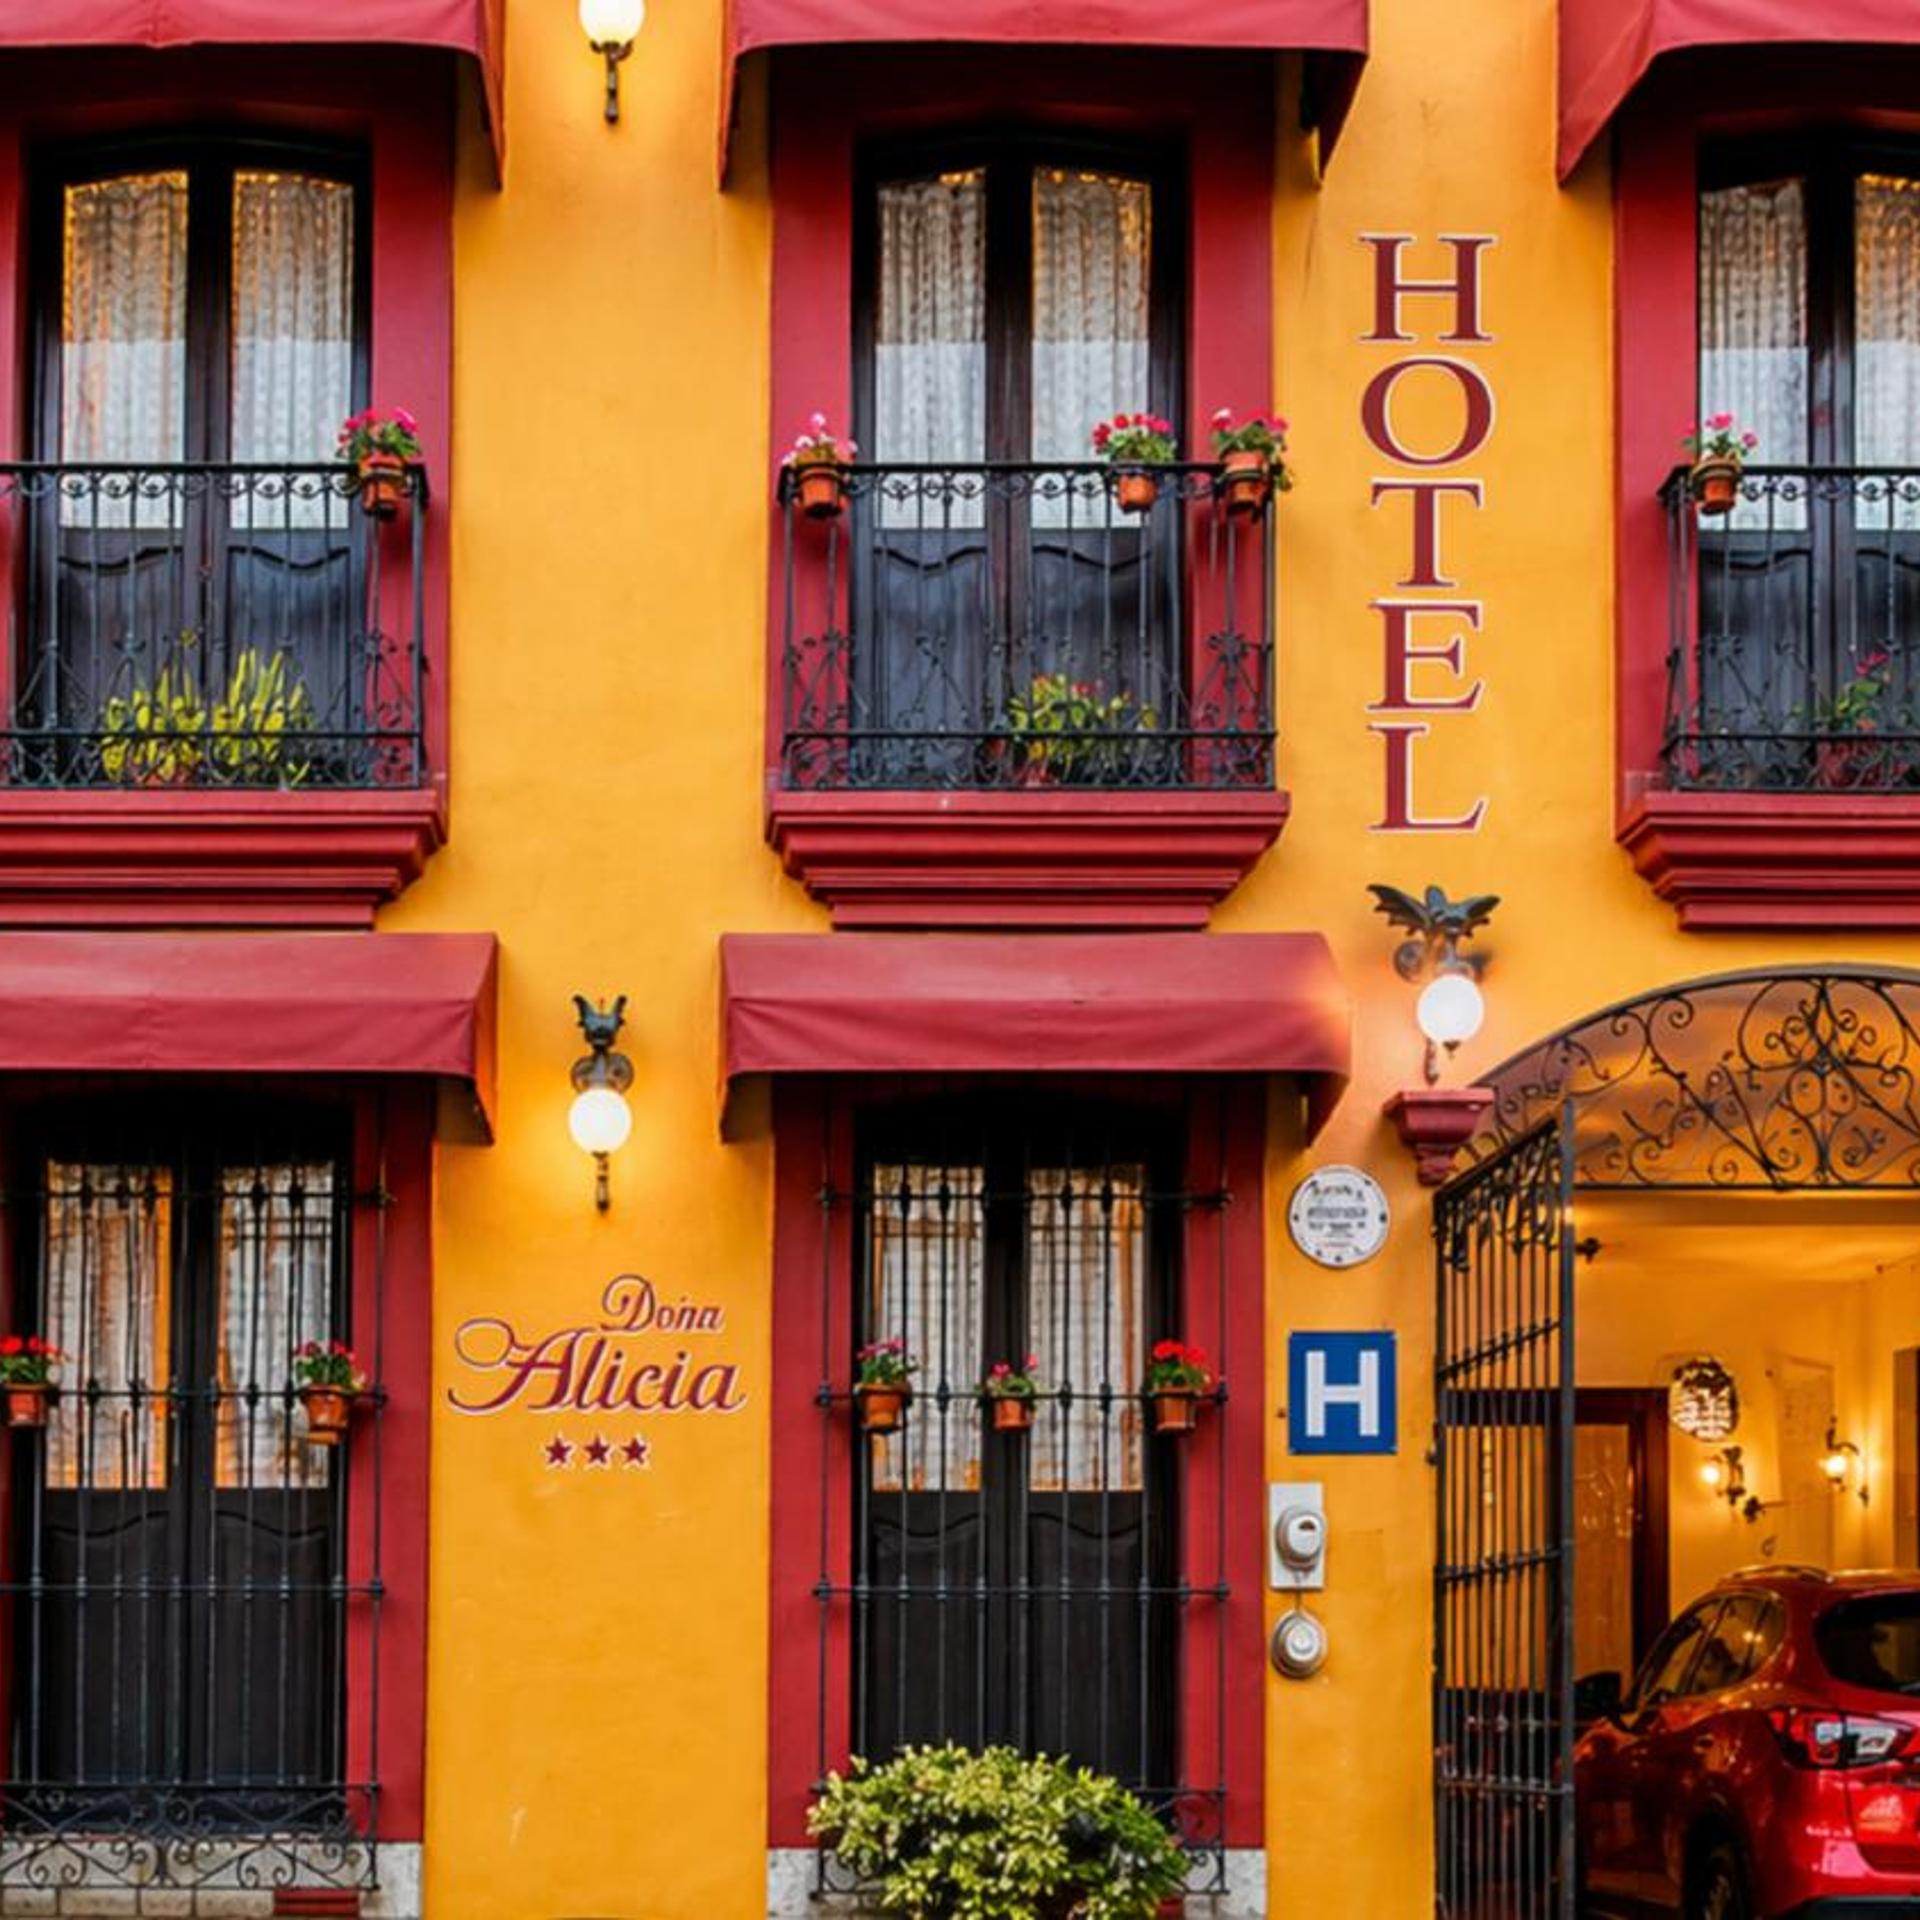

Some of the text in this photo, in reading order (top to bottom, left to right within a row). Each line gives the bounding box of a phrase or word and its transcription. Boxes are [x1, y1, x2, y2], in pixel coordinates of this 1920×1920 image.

[1359, 232, 1499, 835] HOTEL
[447, 1317, 746, 1412] Alicia
[1305, 1350, 1379, 1437] H
